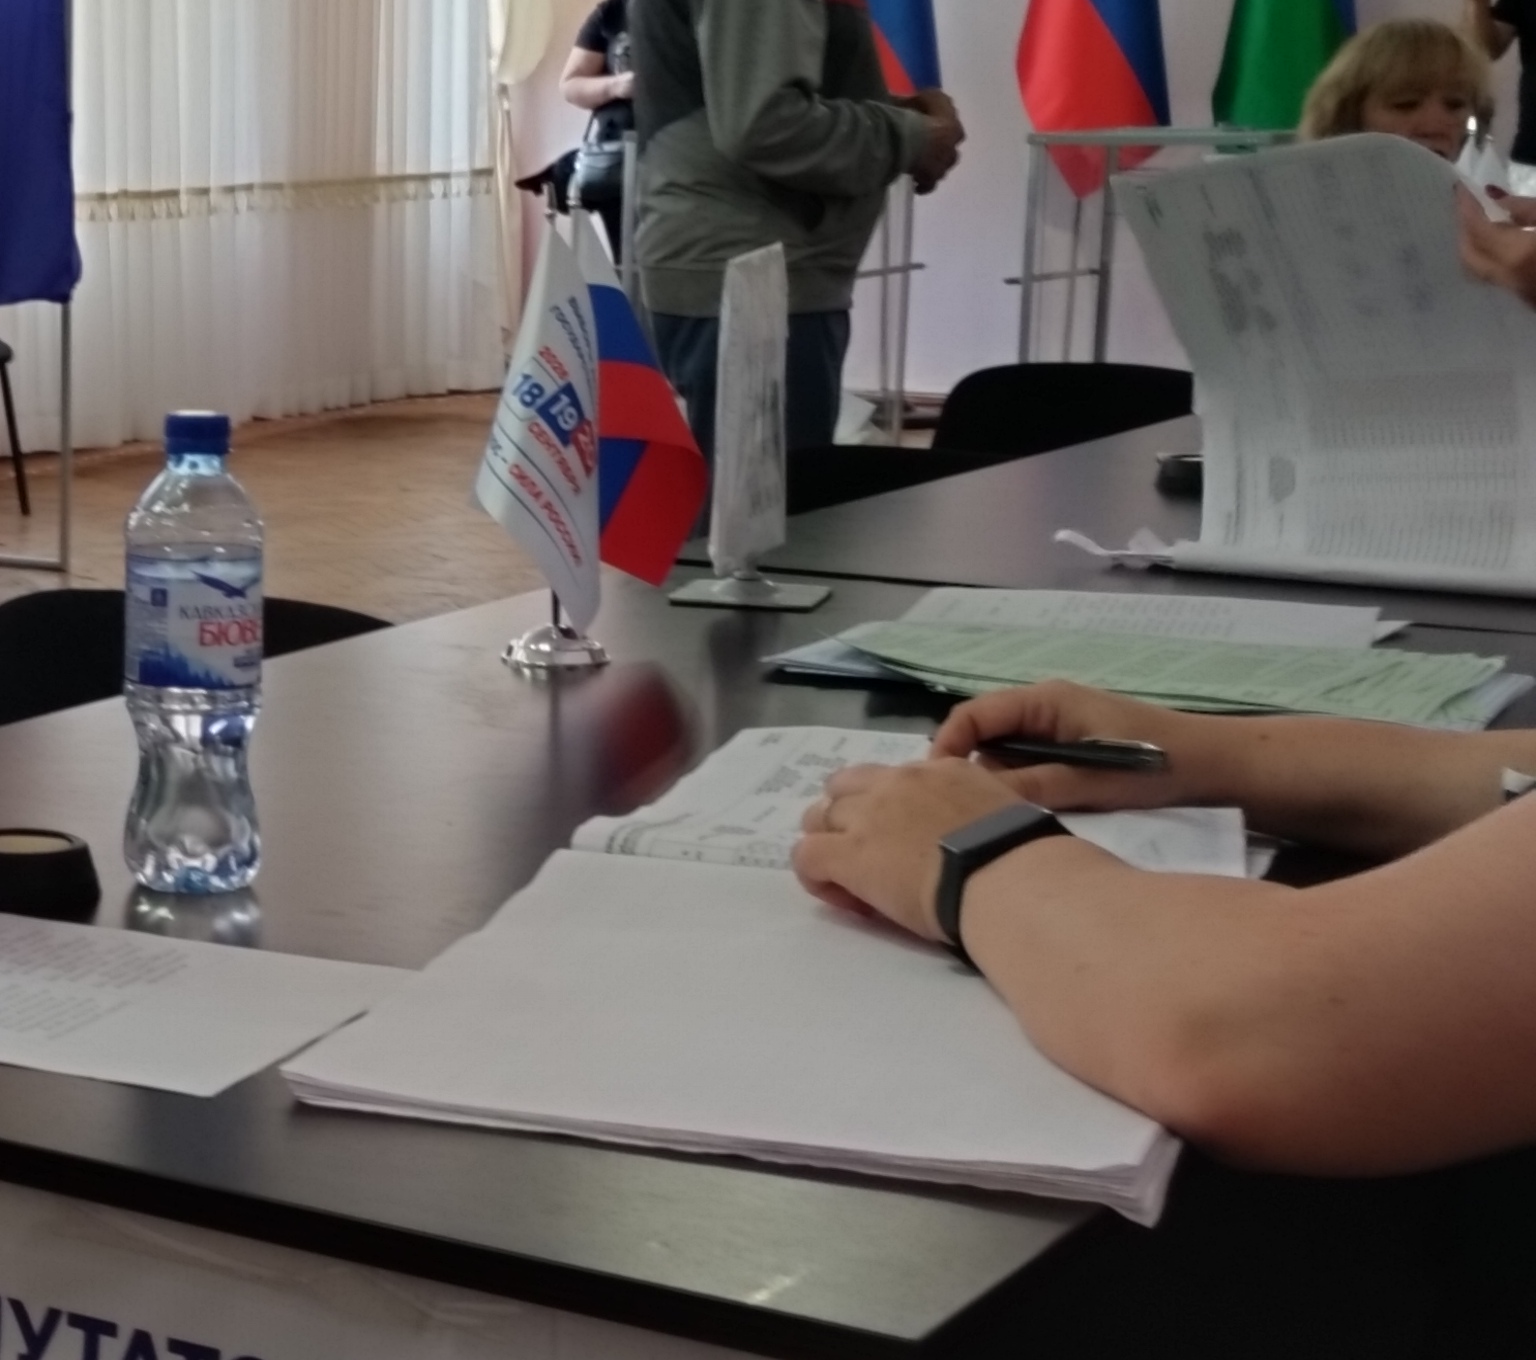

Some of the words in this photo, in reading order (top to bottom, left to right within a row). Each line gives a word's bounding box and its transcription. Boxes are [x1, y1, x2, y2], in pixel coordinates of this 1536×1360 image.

[512, 372, 546, 409] 18
[549, 393, 580, 432] 19
[199, 620, 261, 647] БЮВ
